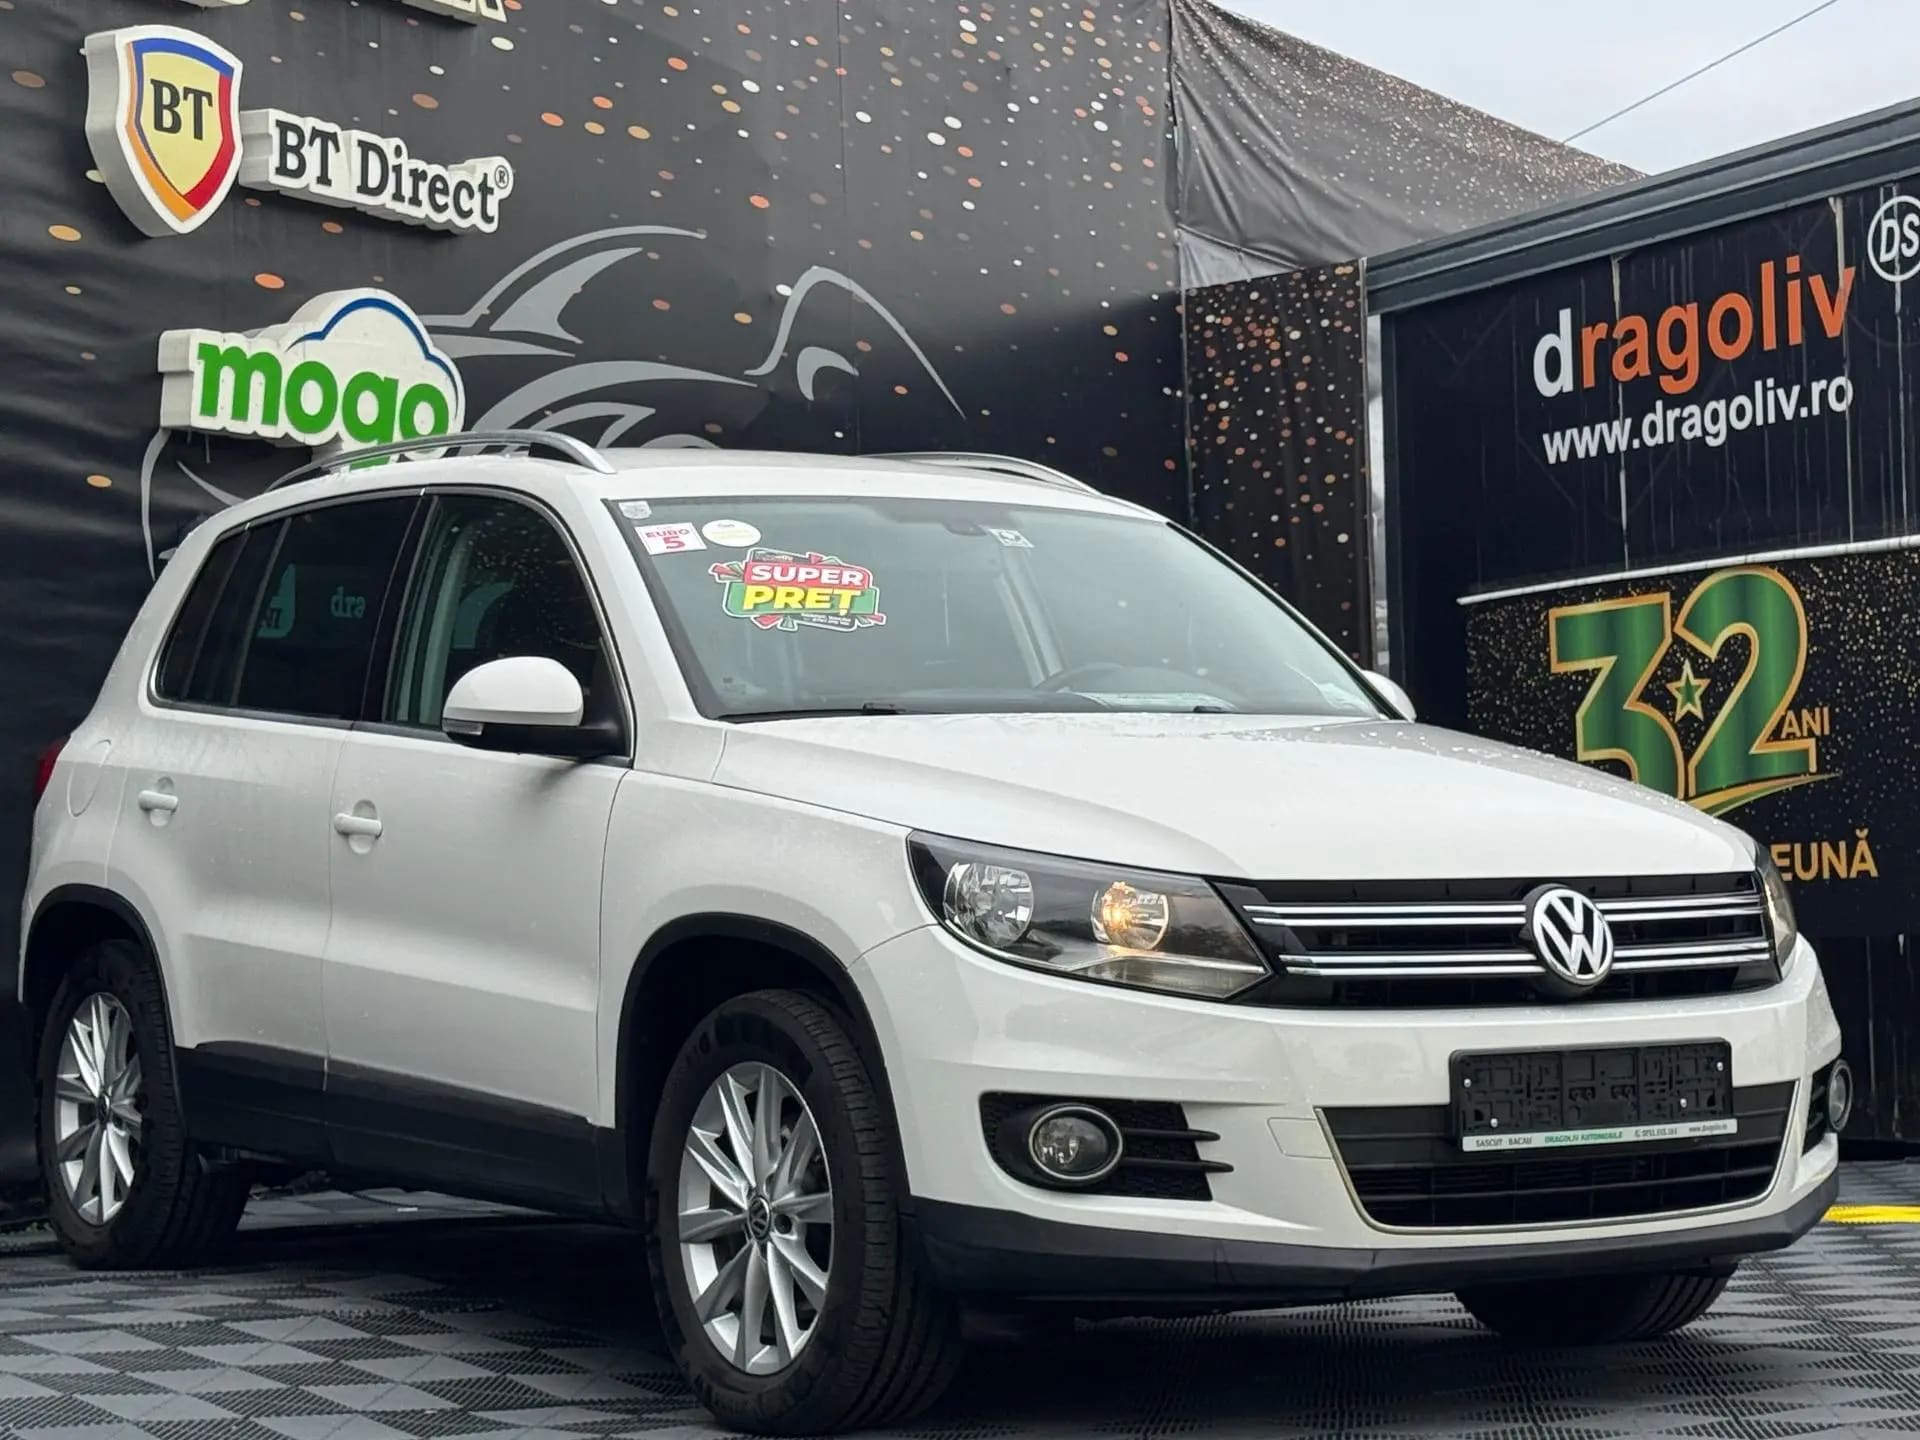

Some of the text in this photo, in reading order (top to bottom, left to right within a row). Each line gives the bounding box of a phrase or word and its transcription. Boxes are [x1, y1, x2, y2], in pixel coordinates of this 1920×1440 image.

[150, 79, 213, 141] BT
[275, 119, 340, 187] BT
[1533, 255, 1856, 397] dragoliv
[197, 342, 449, 470] mogo
[1543, 376, 1854, 464] www.dragoliv.ro
[663, 536, 686, 549] 5
[751, 563, 866, 586] SUPER
[1549, 565, 1817, 800] 32
[1781, 707, 1830, 739] ANI
